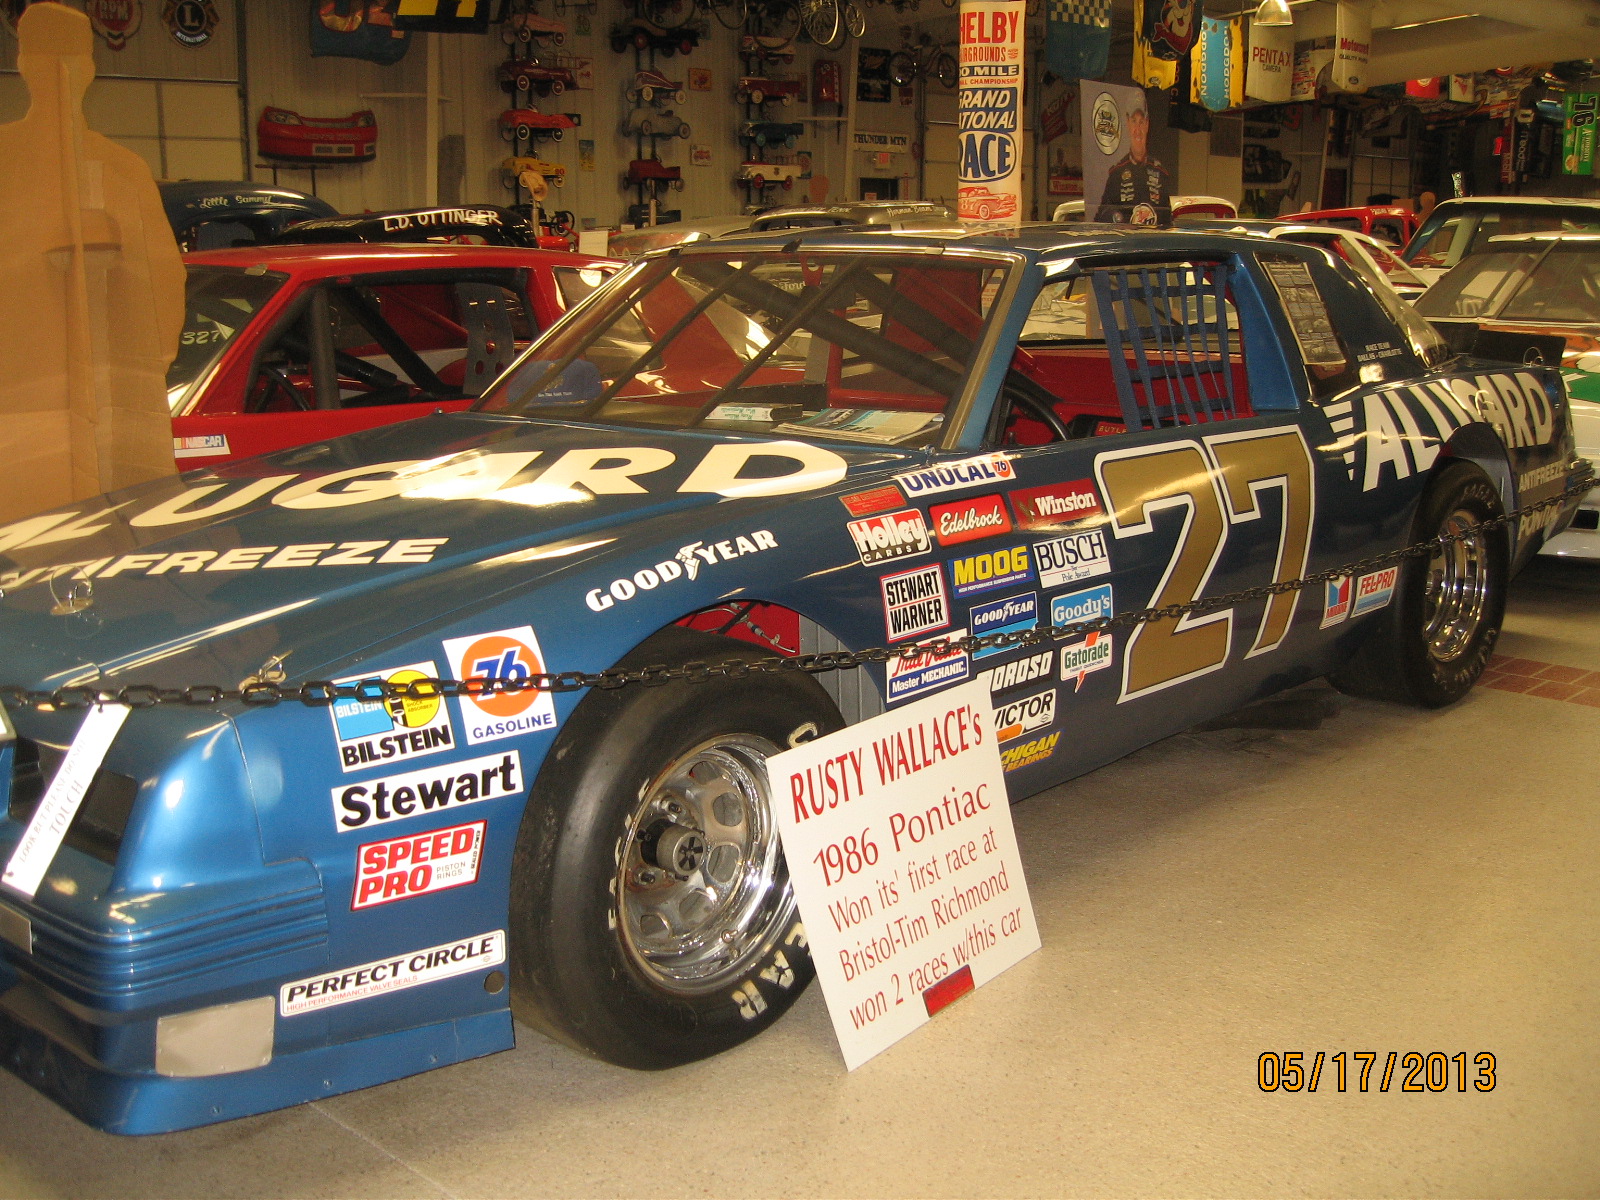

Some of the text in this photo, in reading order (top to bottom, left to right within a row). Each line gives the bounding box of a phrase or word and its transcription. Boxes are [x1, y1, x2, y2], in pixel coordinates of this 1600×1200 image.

[960, 11, 1019, 44] HELBY
[974, 66, 1018, 76] MILE
[1252, 47, 1292, 66] PENTAX
[959, 111, 1015, 129] TIONAL
[384, 209, 503, 232] L.D. OTTINGER
[186, 436, 222, 449] NASCAR
[1099, 426, 1128, 434] BUTLE
[902, 460, 1008, 492] UNOCAL 76
[1519, 461, 1564, 493] ANTIFREEZE
[940, 505, 1002, 536] Edelbrock
[1036, 492, 1096, 516] Winston
[850, 516, 928, 552] Holley
[0, 538, 449, 589] NTIFREEZE
[864, 545, 912, 561] CARBS
[954, 546, 1028, 586] MOOG
[1034, 533, 1106, 572] BUSCH
[1094, 424, 1316, 705] 27
[886, 570, 940, 606] STEWART
[1062, 573, 1073, 582] Pole
[1074, 568, 1091, 580] Award
[890, 601, 944, 634] WARNER
[1054, 595, 1110, 622] Goody's
[1064, 642, 1108, 670] Gatorade
[471, 646, 530, 701] 76
[892, 676, 919, 693] Master
[336, 702, 383, 718] BILSTEIN
[406, 700, 423, 708] SHOCK
[473, 713, 552, 738] GASOLINE
[342, 724, 452, 766] BILSTEIN
[1000, 731, 1060, 765] CHIGAN
[790, 703, 982, 824] RUSTY WALLACE's
[340, 754, 516, 828] Stewart
[362, 828, 474, 875] SPEED
[813, 782, 990, 888] 1986 Pontiac
[358, 864, 432, 904] PRO
[436, 861, 466, 874] PISTON
[436, 868, 462, 880] RINGS
[828, 899, 874, 934] Won
[907, 858, 942, 894] first
[946, 840, 976, 873] race
[982, 826, 998, 855] at
[838, 860, 1010, 982] Bristol-Tim Richmond
[287, 936, 494, 1004] PERFECT CIRCLE
[848, 906, 1022, 1030] won 2 races w/this car
[286, 975, 418, 1012] HIGH PERFORMANCE VALVE SEALS
